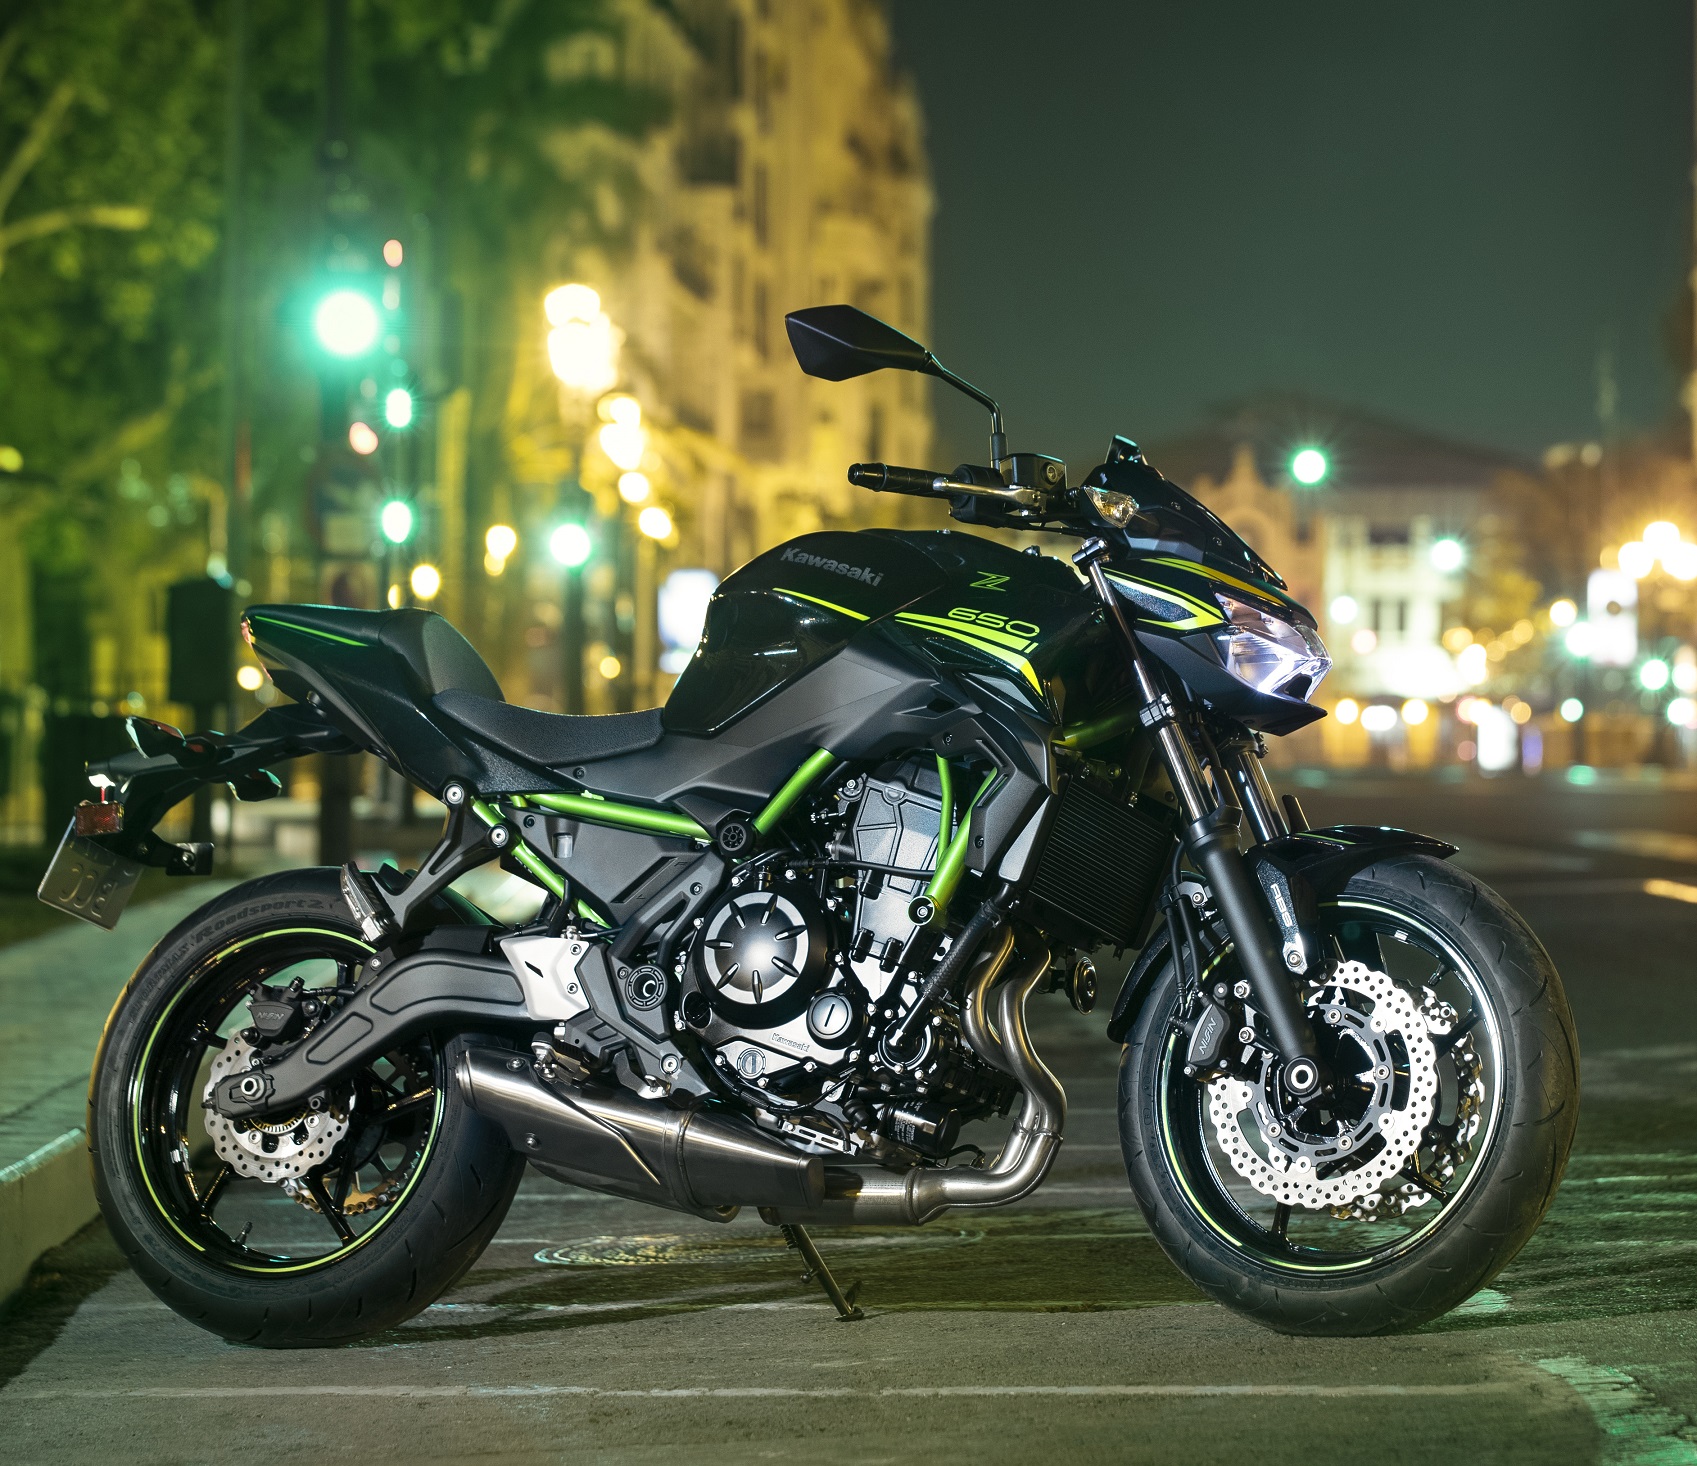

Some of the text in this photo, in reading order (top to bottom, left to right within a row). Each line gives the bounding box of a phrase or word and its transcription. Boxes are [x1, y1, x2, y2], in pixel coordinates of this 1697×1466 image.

[780, 547, 884, 587] Kawasaki
[948, 607, 1040, 638] 650
[1270, 883, 1294, 928] ABS
[771, 1032, 811, 1053] Kawasaki
